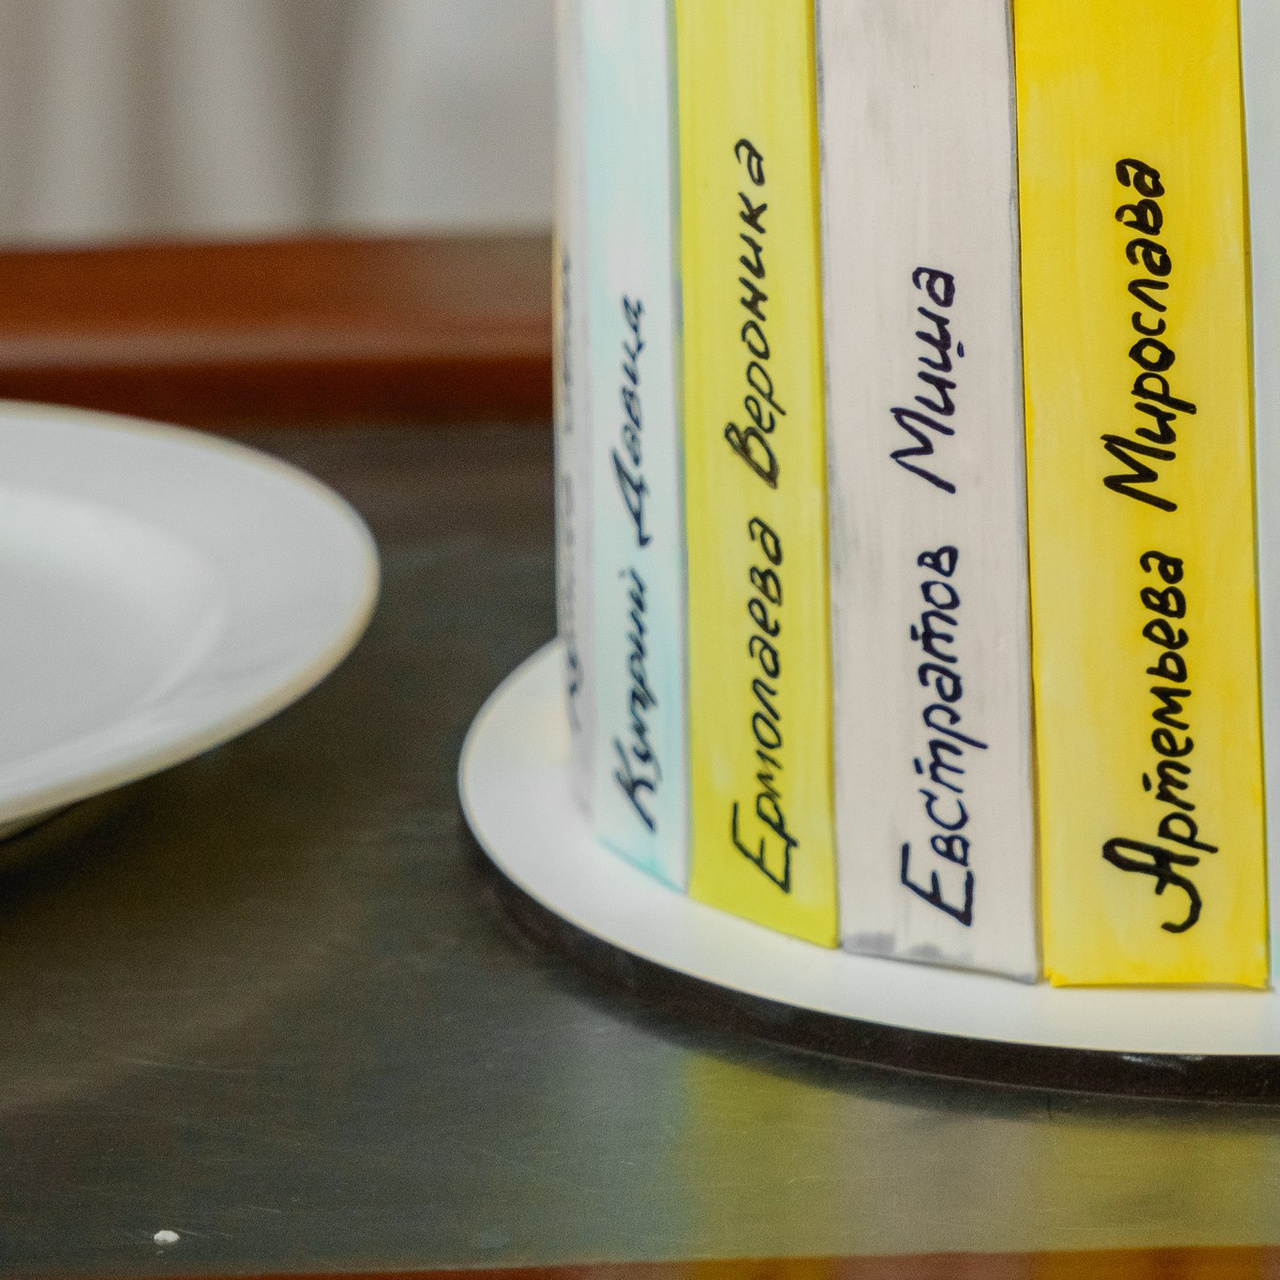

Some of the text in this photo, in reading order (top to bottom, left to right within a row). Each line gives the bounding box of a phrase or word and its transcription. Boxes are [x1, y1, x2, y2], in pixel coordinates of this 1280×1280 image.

[725, 139, 797, 893] Ермолаева Вероника
[890, 267, 987, 926] Евстратов Миша
[1101, 159, 1218, 933] Артемьева Мирослава
